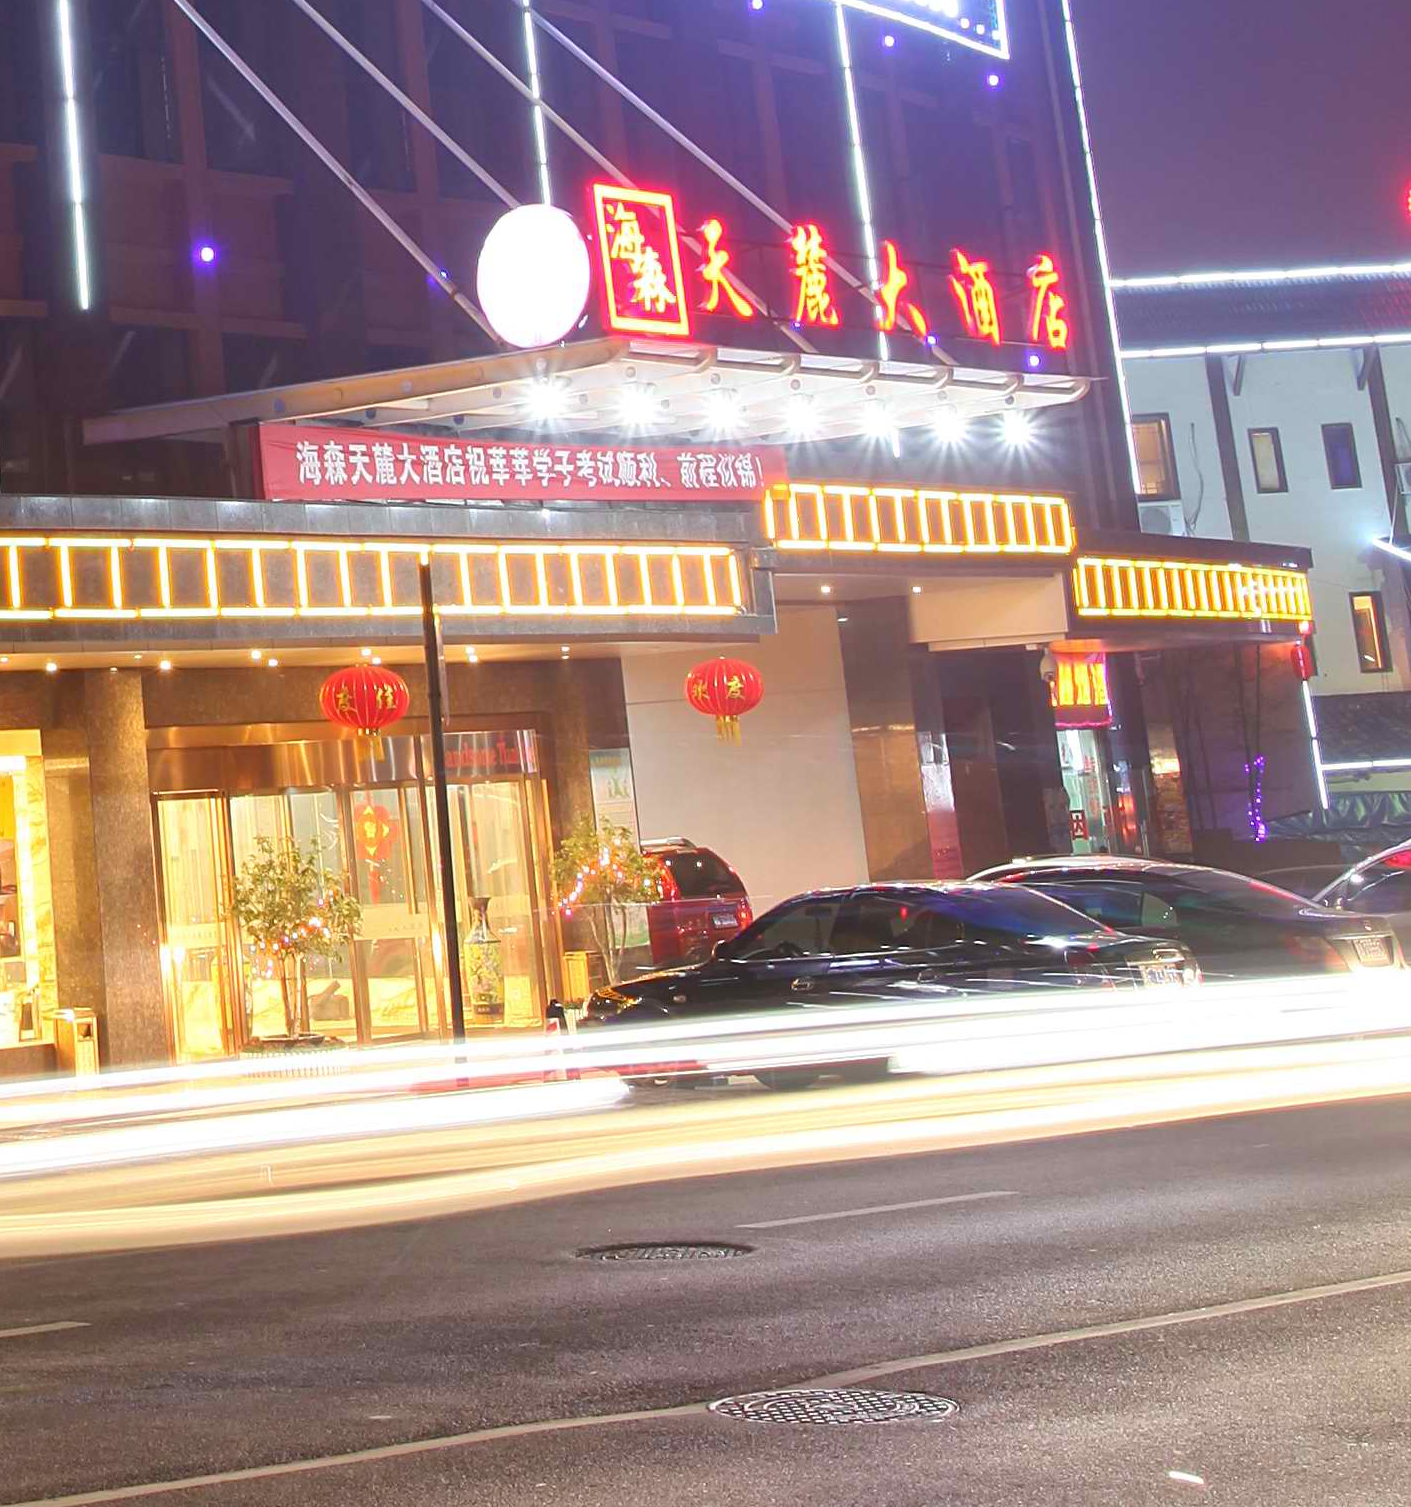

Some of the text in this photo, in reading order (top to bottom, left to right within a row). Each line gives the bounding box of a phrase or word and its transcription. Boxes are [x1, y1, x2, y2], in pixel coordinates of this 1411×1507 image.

[606, 202, 677, 313] 海森
[696, 217, 1069, 351] 天麓大酒店
